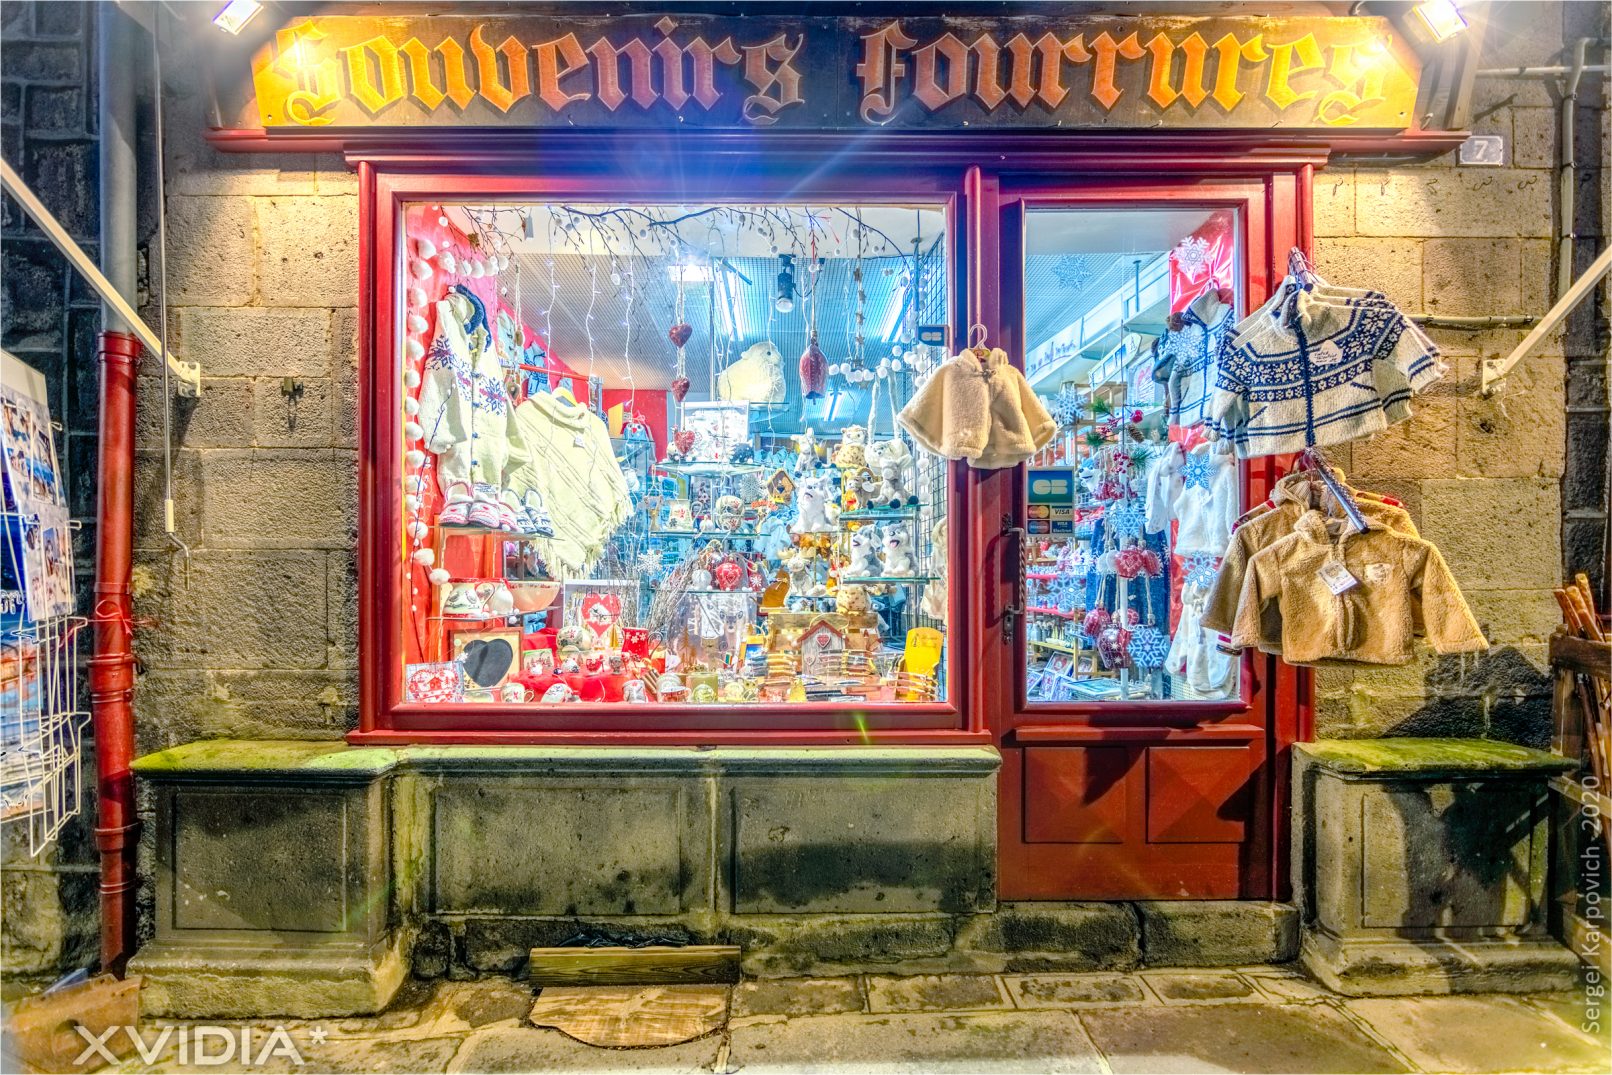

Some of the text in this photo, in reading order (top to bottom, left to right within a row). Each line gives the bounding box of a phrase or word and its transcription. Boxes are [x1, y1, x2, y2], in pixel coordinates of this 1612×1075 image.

[274, 16, 1392, 127] Souvenirs Fourrures
[1474, 140, 1489, 160] 7
